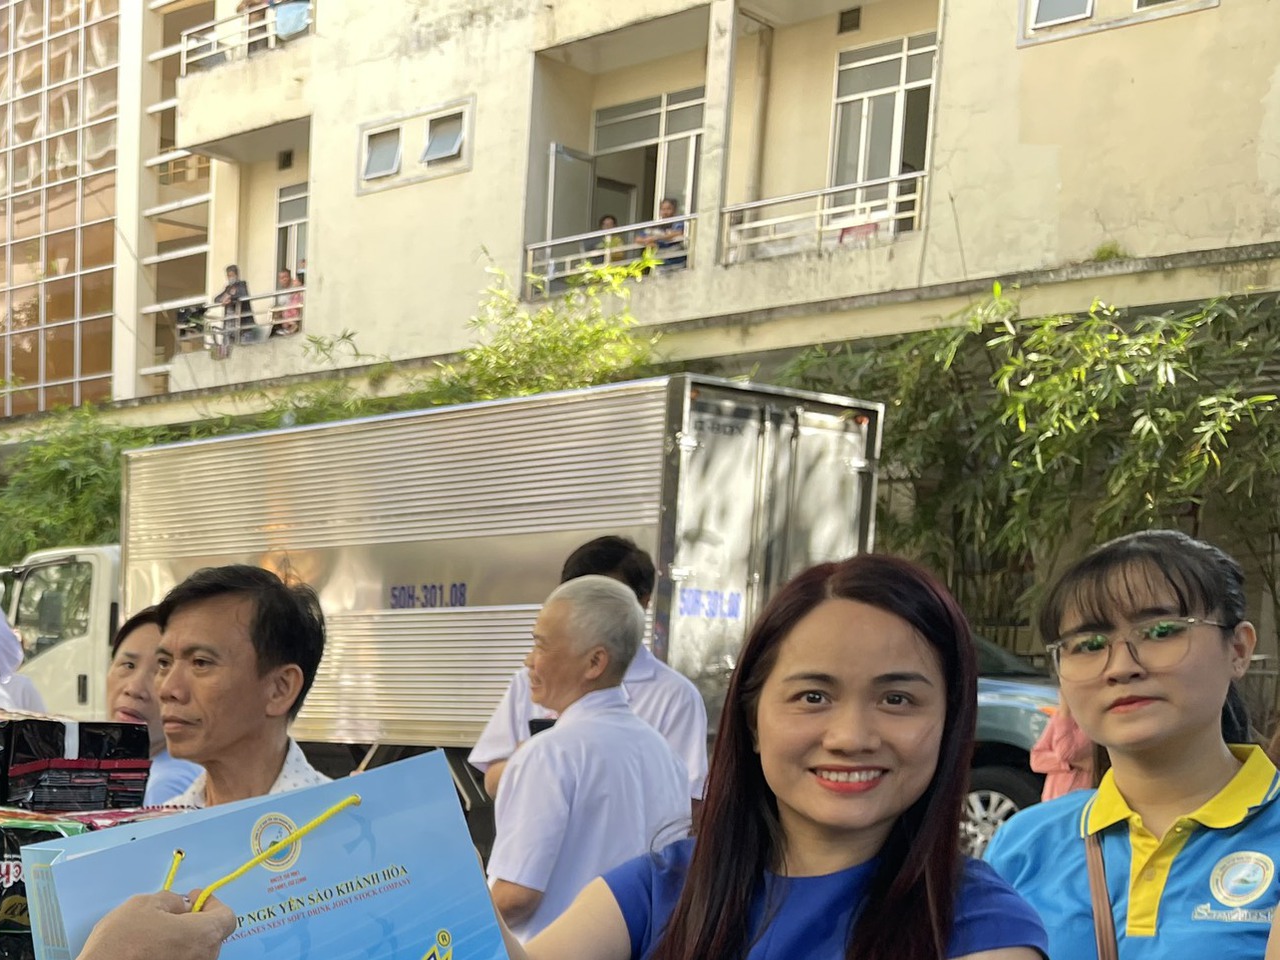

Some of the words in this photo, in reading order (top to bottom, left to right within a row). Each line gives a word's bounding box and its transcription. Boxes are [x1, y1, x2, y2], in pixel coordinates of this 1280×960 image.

[246, 906, 277, 926] NGK
[279, 894, 307, 914] YẾN
[307, 888, 333, 905] SÀO
[335, 873, 380, 898] KHÁNH
[382, 863, 409, 882] HÒA
[221, 925, 266, 944] ALANGANES
